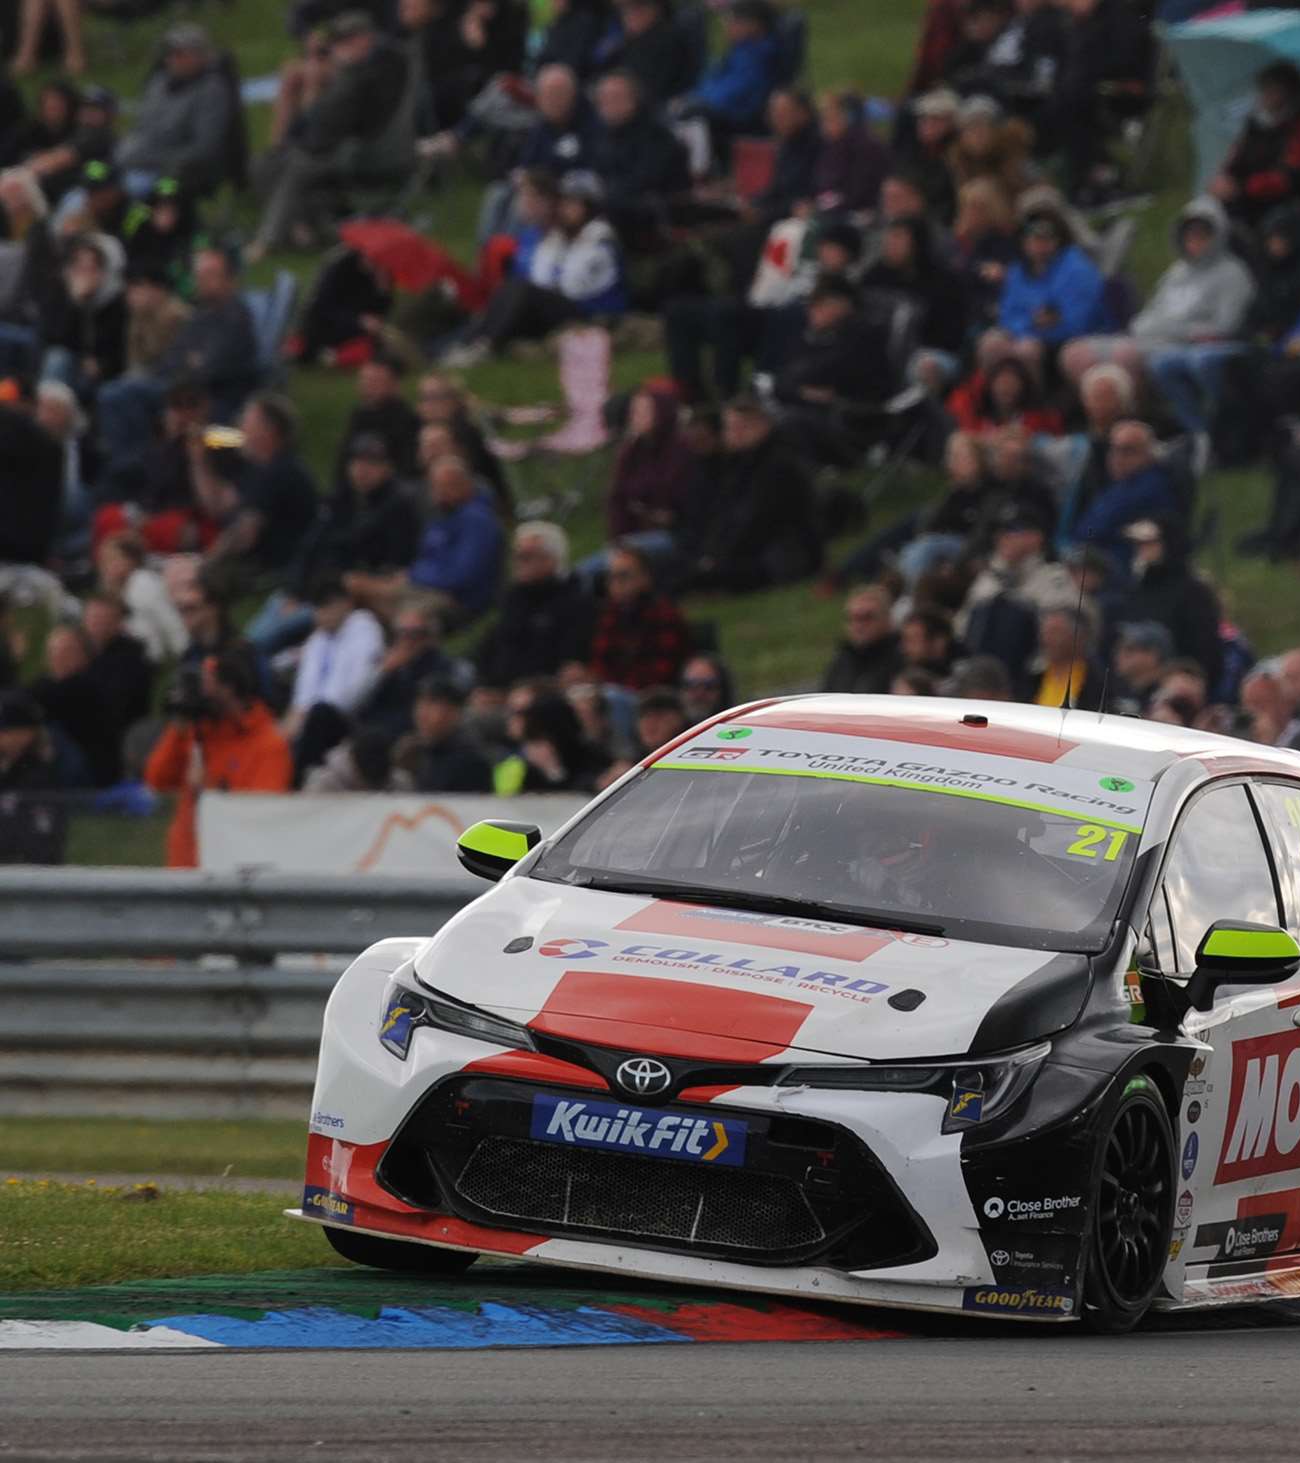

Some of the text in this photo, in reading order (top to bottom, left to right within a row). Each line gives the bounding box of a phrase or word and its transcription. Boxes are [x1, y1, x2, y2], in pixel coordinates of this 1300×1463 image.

[757, 749, 1138, 815] TOYOTA GAZOO Racing
[807, 760, 983, 790] United Kingdom
[1066, 824, 1128, 861] 21
[611, 955, 872, 1004] DEMOLISH DISPOSE RECYCLE
[620, 944, 890, 995] COLLARD
[1007, 1200, 1042, 1213] Close
[975, 1289, 1065, 1310] GOODYEAR
